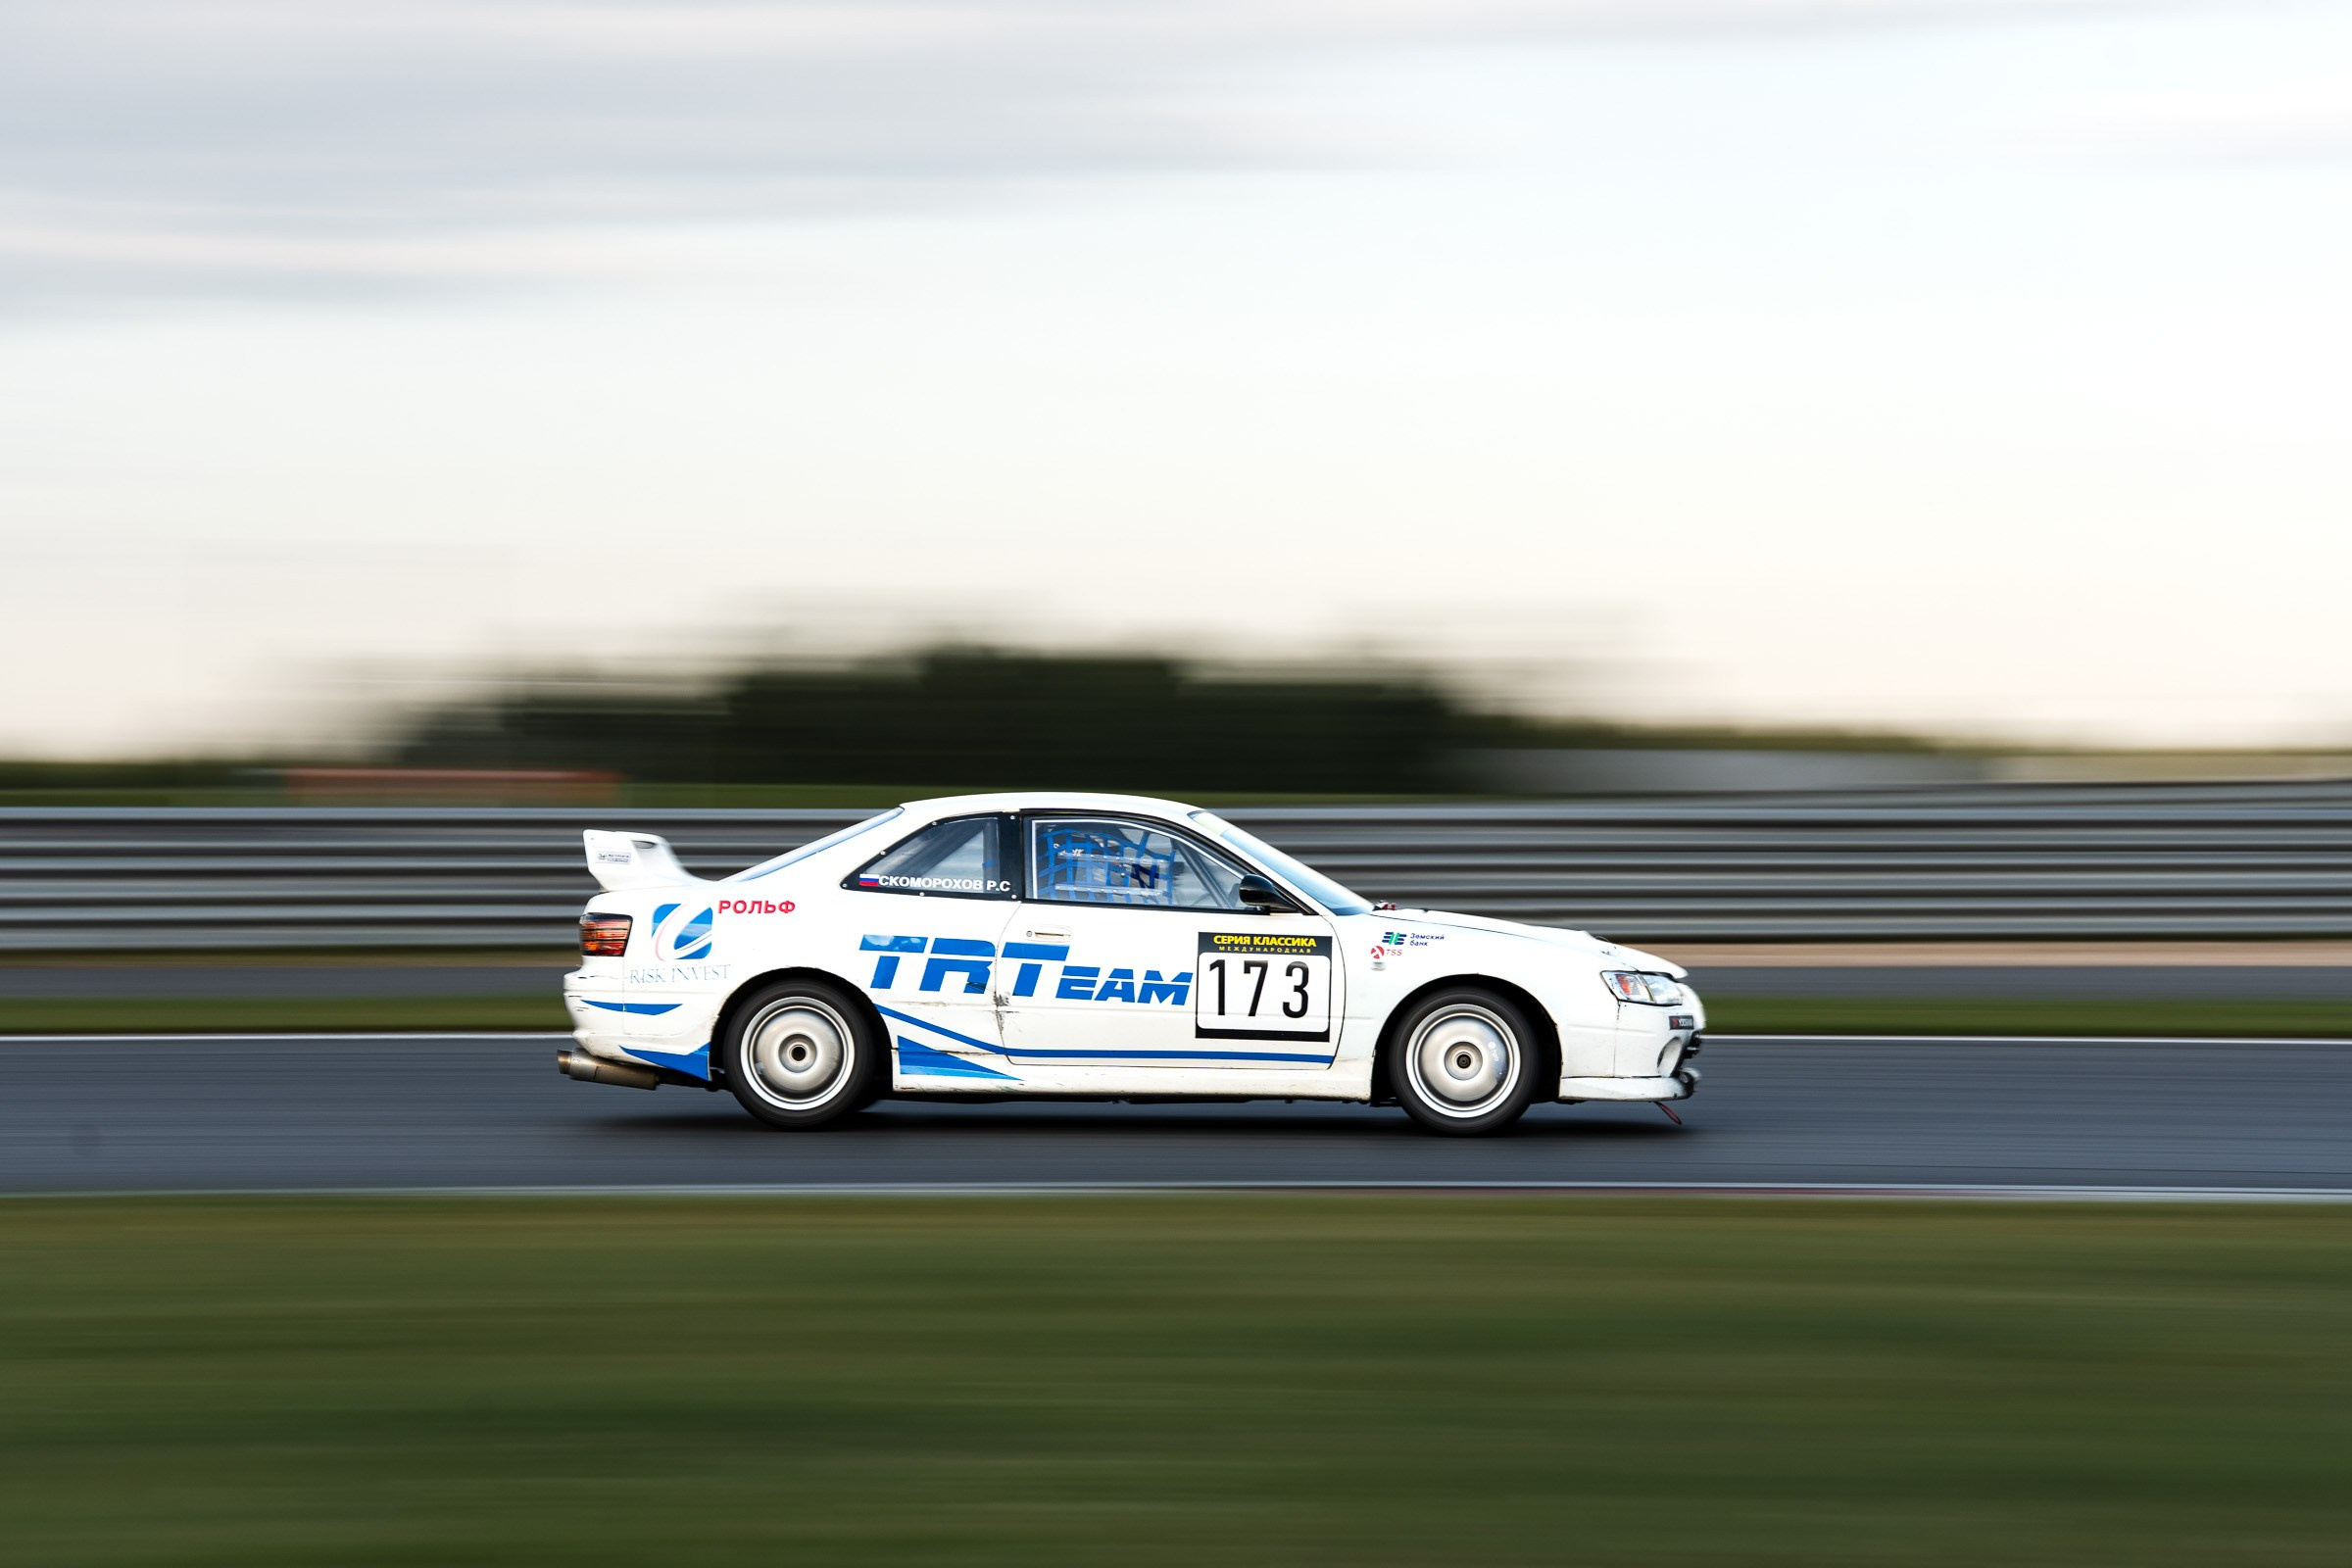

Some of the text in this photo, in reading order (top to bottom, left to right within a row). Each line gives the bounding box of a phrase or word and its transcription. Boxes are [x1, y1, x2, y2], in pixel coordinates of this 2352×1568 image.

[878, 875, 983, 890] СКОМОРОХОВ
[718, 900, 796, 914] РОЛЬФ
[1213, 935, 1317, 948] СЕРИЯ КЛАССИКА
[630, 964, 731, 983] RISK INVEST
[1208, 958, 1309, 1019] 173
